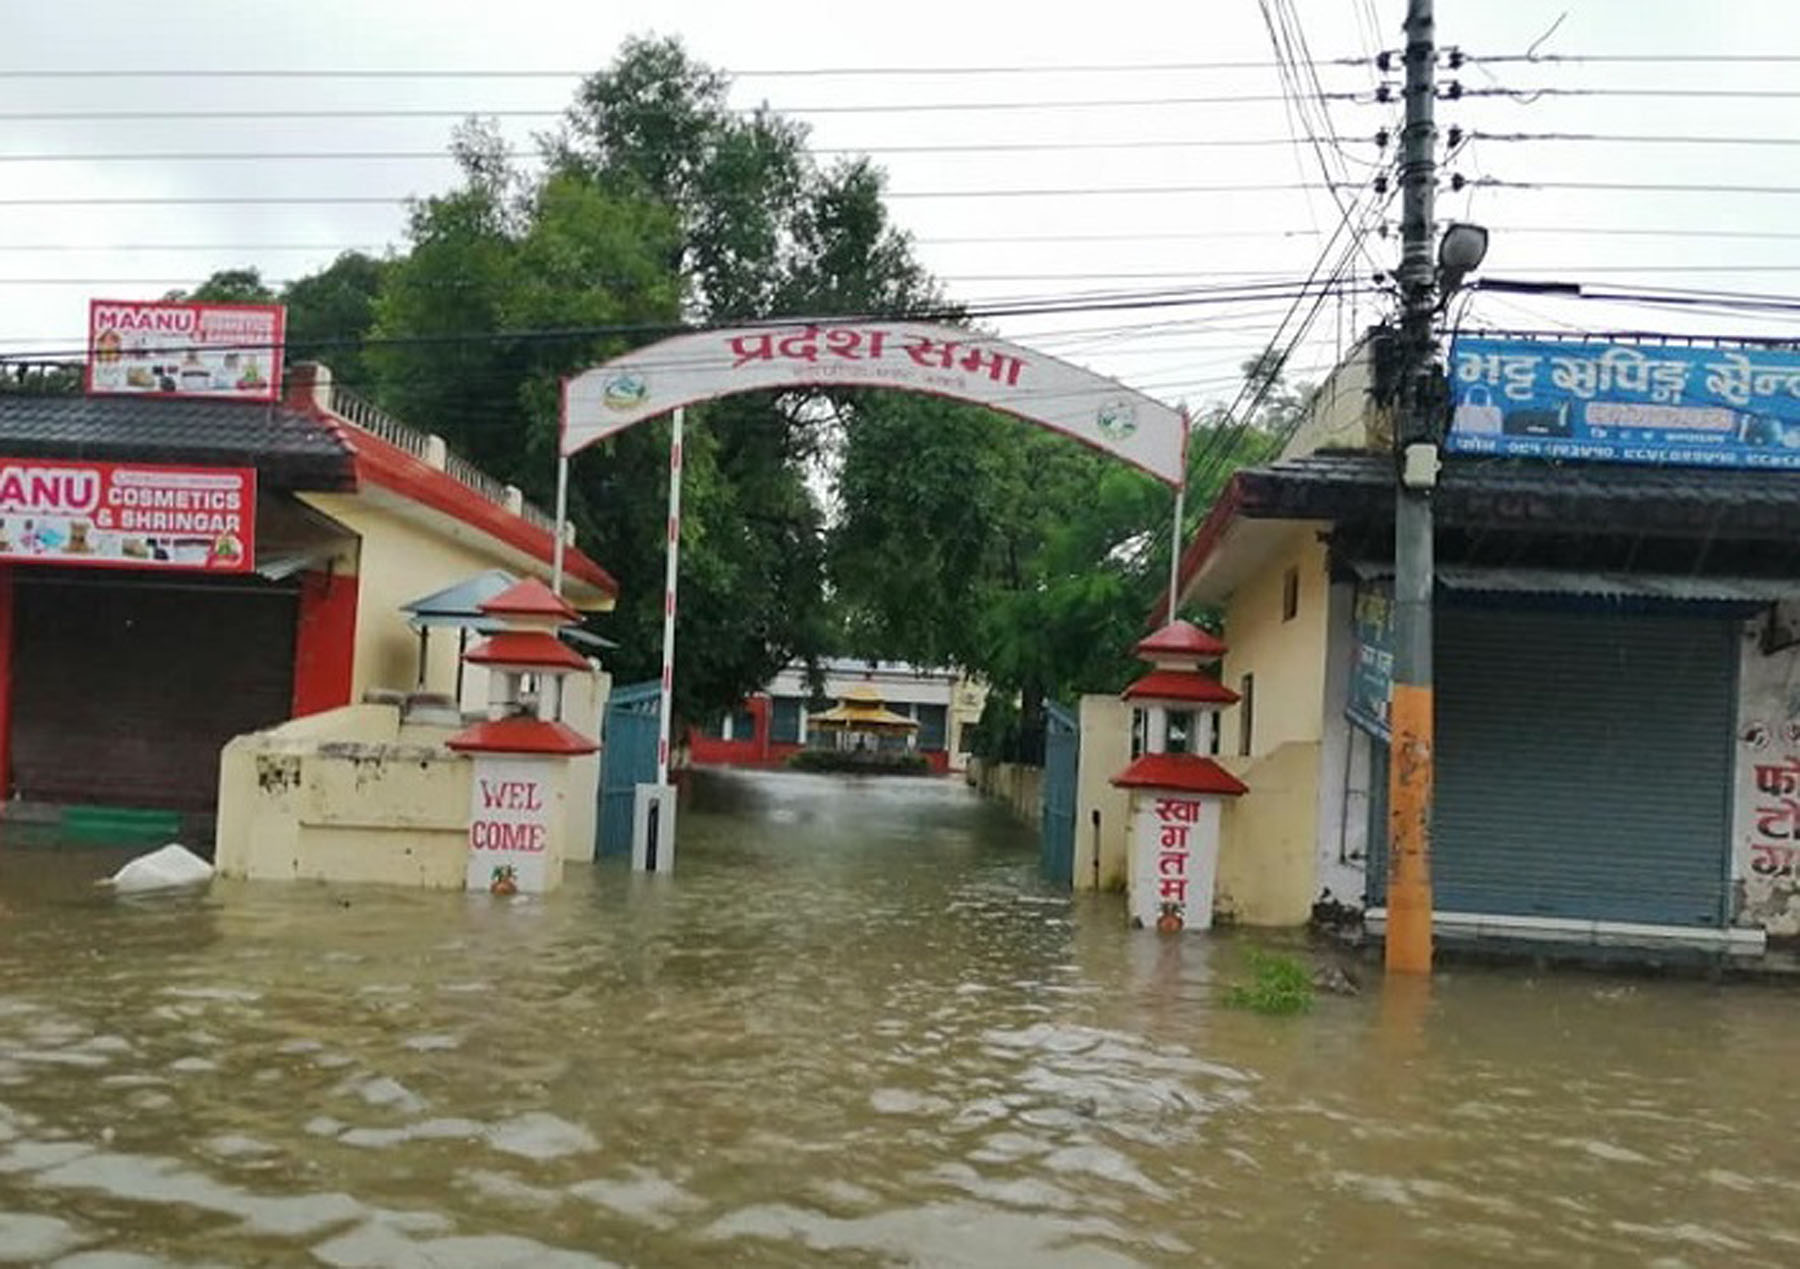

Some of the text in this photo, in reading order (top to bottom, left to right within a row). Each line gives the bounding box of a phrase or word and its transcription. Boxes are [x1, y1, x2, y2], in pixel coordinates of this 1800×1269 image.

[97, 307, 193, 332] MAANU
[724, 325, 889, 368] प्रदेश
[902, 333, 1027, 386] सभा
[108, 487, 241, 510] COSMETICS
[96, 508, 242, 533] & SHRINGAR
[480, 780, 542, 811] WEL
[472, 820, 546, 853] COME
